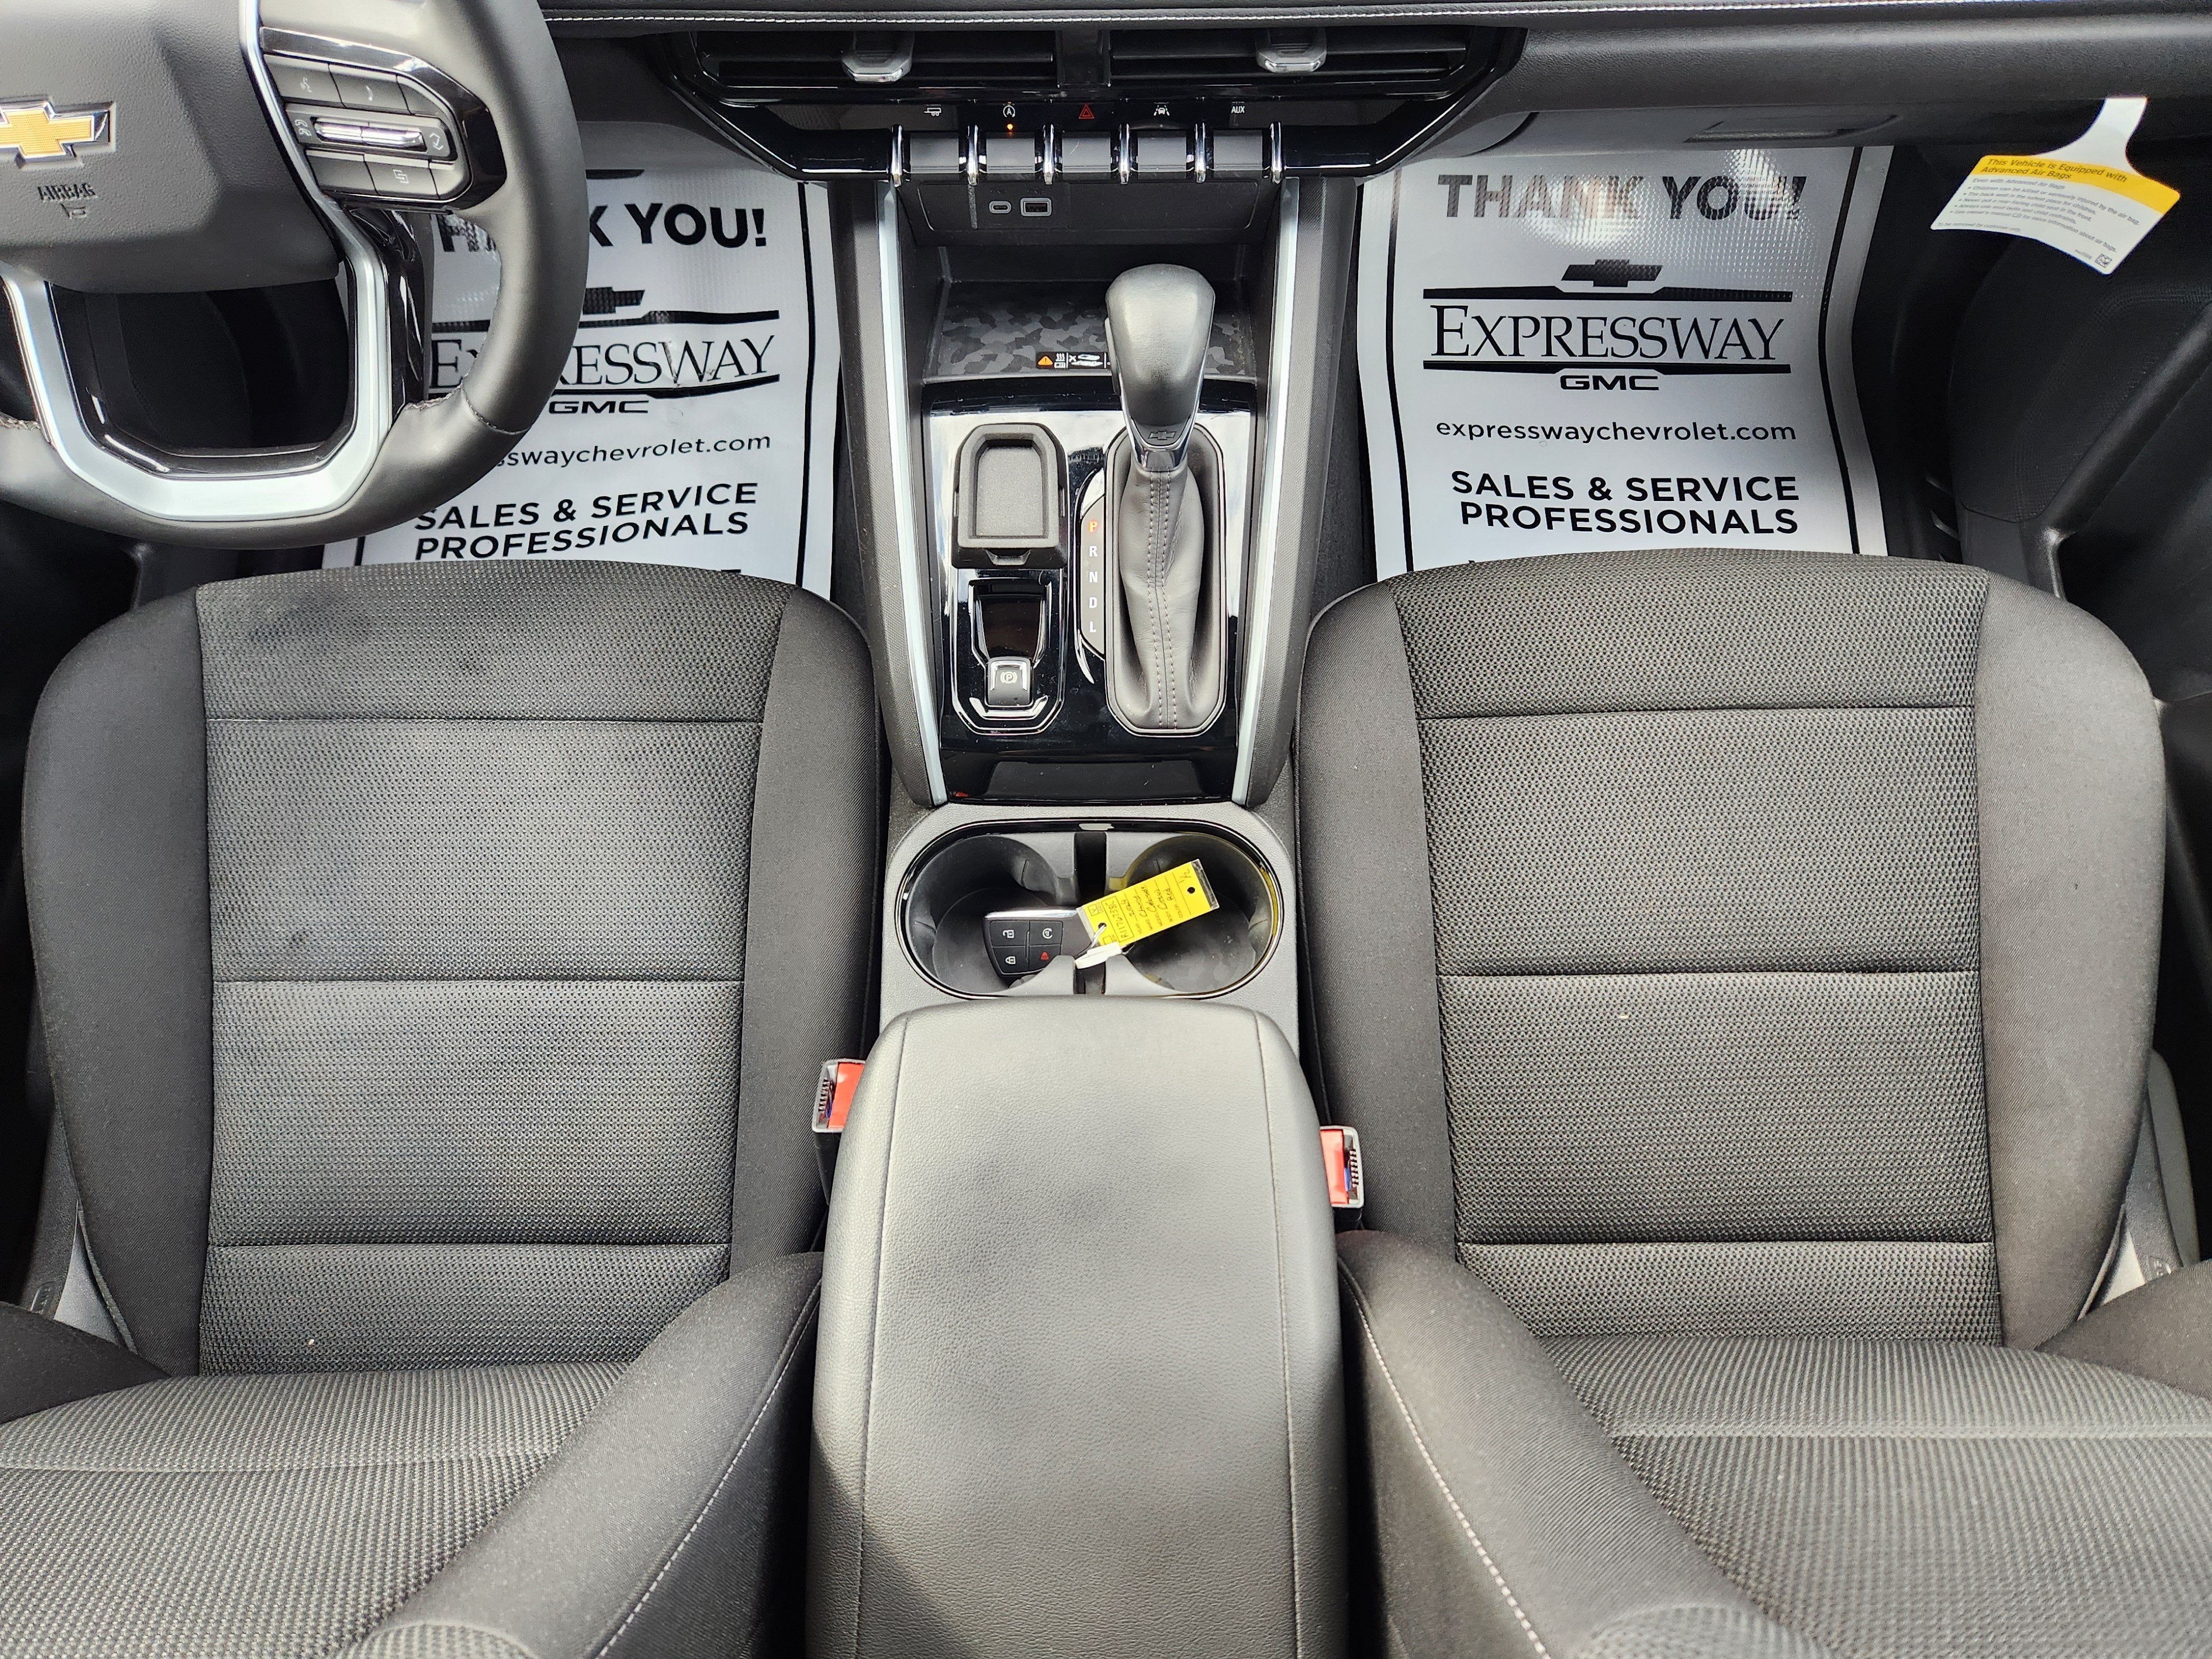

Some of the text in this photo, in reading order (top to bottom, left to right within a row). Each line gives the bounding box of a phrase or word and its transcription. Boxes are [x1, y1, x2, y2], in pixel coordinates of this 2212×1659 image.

[2011, 159, 2045, 168] Vehicle
[2058, 164, 2105, 176] Equipped
[2106, 171, 2127, 182] with
[2047, 171, 2072, 180] Bags
[1438, 174, 1807, 221] THANK YOU!
[624, 202, 766, 248] YOU!
[430, 335, 775, 389] EESSWAY
[1560, 375, 1660, 390] GMC
[549, 400, 649, 414] GMC
[1437, 420, 1796, 442] expresswaychevrolet.com
[497, 436, 771, 468] swaychevrolet.com
[1452, 470, 1799, 502] SALES & SERVICE
[414, 482, 758, 530] SALES & SERVICE
[1088, 520, 1098, 533] P
[1462, 501, 1798, 534] PROFESSIONALS
[415, 512, 749, 560] PROFESSIONALS
[1089, 546, 1098, 557] R
[1089, 571, 1098, 582] N
[1089, 597, 1097, 608] D
[1089, 622, 1097, 633] L
